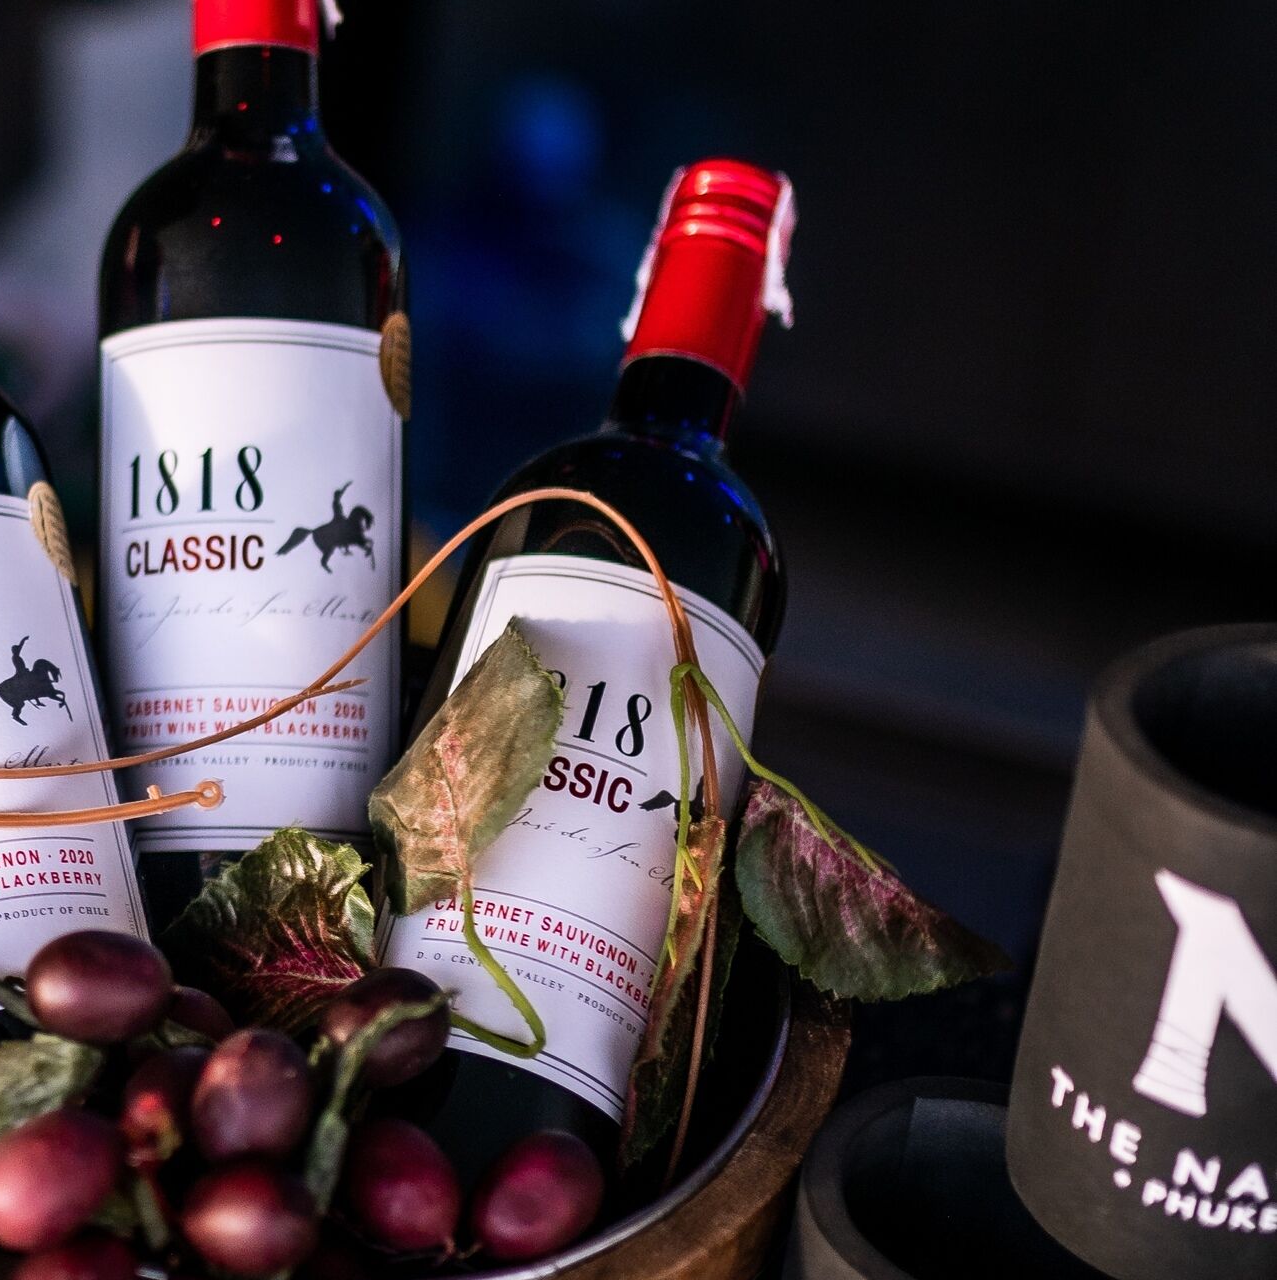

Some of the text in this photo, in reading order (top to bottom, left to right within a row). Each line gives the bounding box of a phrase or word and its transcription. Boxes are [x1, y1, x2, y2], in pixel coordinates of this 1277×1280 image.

[129, 445, 264, 520] 1818
[126, 534, 264, 578] CLASSIC
[126, 697, 203, 718] CABERNET
[334, 701, 365, 720] 2020
[167, 721, 206, 735] WINE
[264, 721, 369, 743] BLACKBERRY
[203, 756, 250, 766] VALLEY
[264, 757, 318, 769] PRODUCT
[59, 849, 95, 865] 2020
[59, 905, 74, 915] OF
[78, 906, 110, 917] CHILE
[485, 925, 530, 947] WINE
[537, 938, 580, 966] WITH
[585, 959, 653, 1011] BLACKBE
[541, 916, 637, 974] SAUVIGNON
[516, 967, 565, 993] VALLEY
[577, 992, 625, 1026] PRODUCT
[1051, 1065, 1277, 1202] THE NA
[1142, 1177, 1277, 1234] PHUKE
